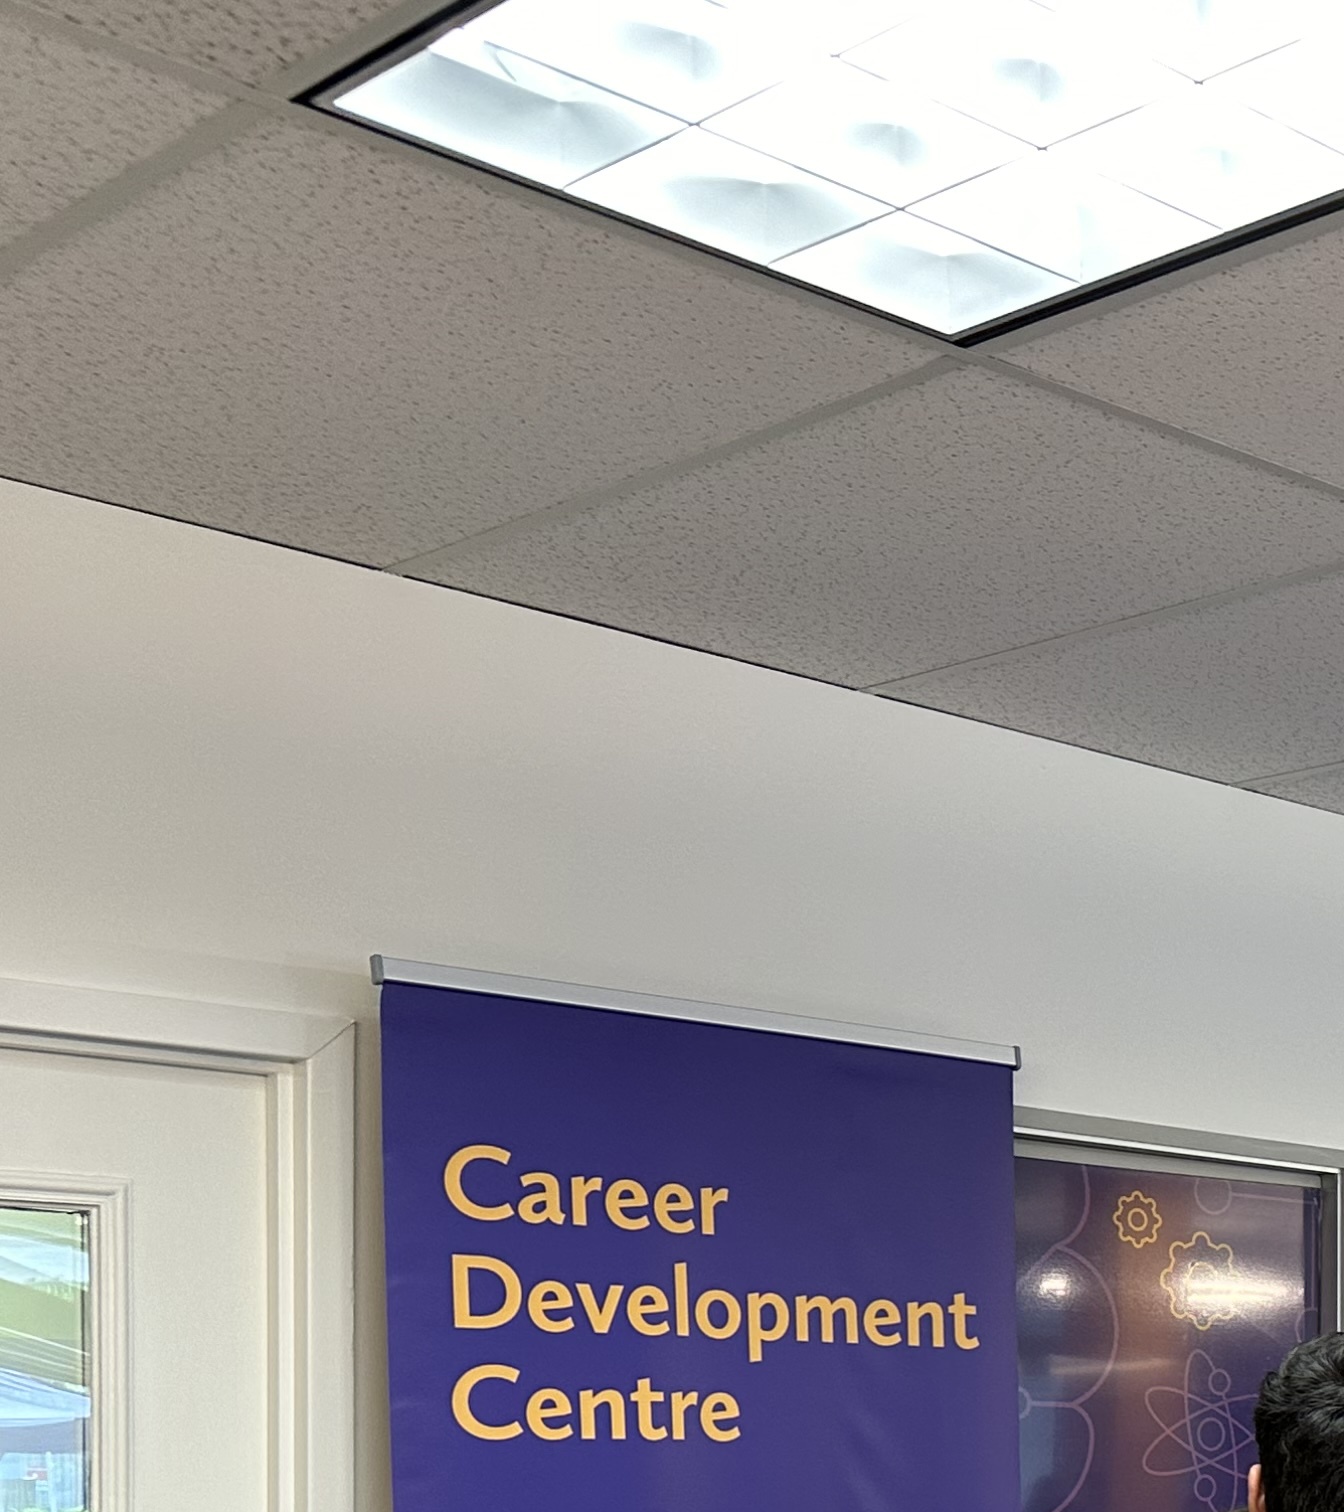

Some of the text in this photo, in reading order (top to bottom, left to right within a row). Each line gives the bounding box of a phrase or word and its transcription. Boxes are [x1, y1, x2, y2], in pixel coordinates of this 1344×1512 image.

[443, 1145, 729, 1235] Career
[450, 1254, 980, 1362] Development
[450, 1363, 741, 1442] Centre
